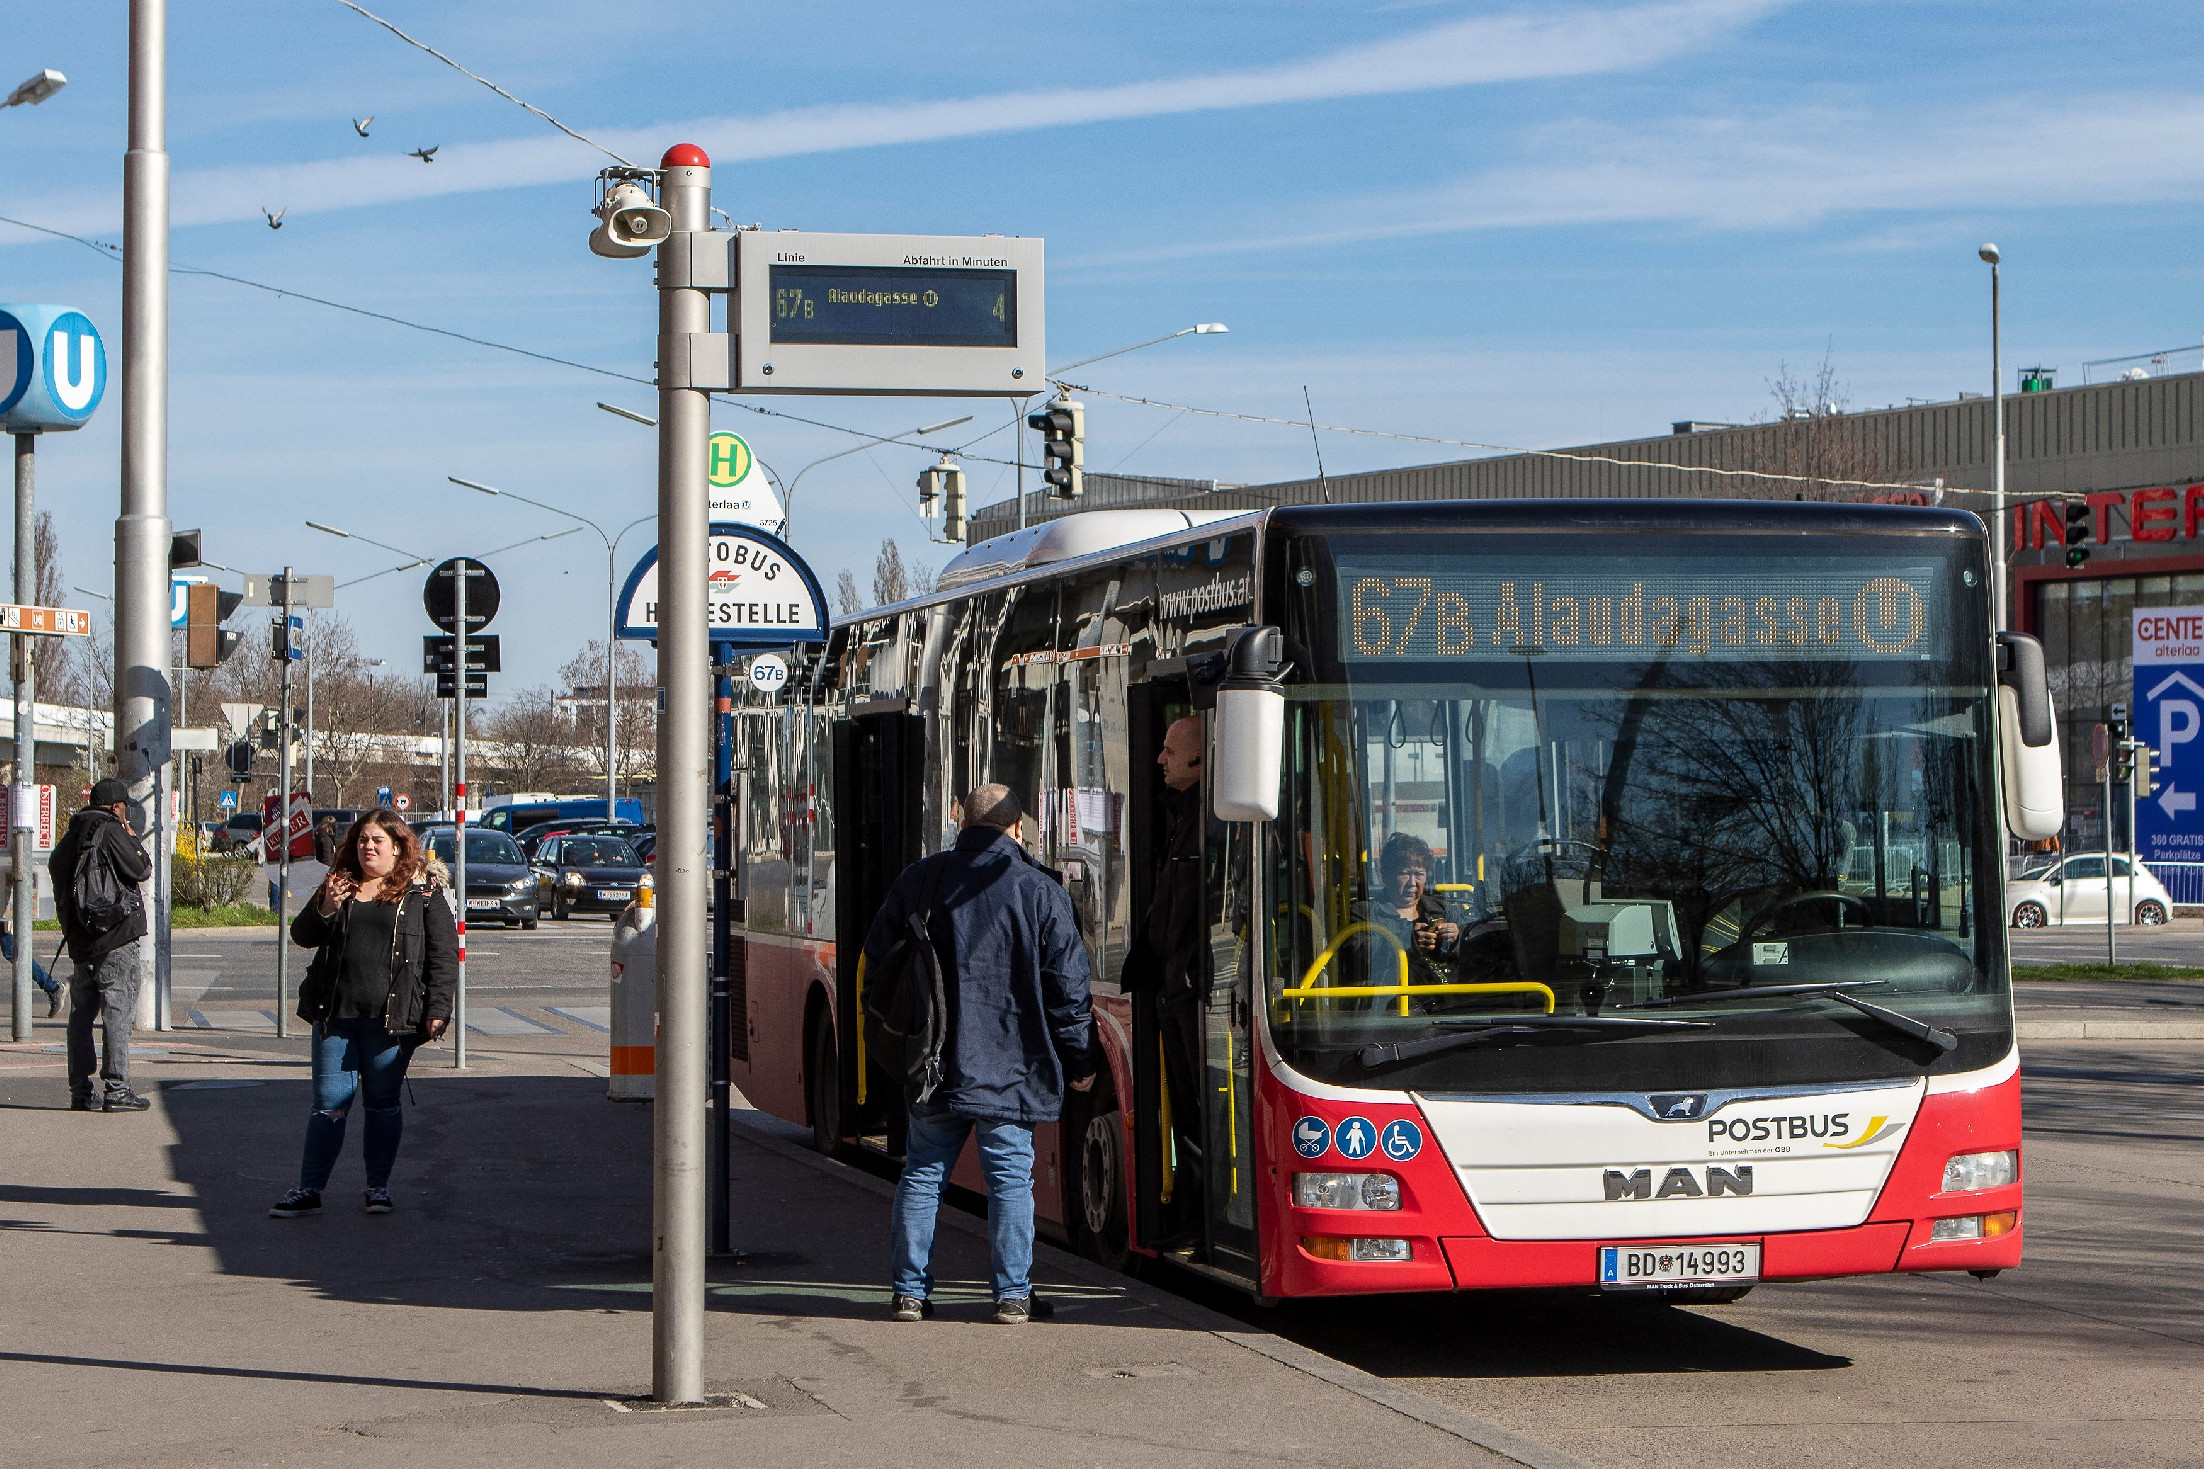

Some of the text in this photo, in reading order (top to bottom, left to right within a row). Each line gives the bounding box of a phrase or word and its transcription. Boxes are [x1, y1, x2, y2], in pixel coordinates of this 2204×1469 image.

[777, 252, 806, 264] Linie
[903, 255, 1008, 268] Abfahrt in Minuten
[776, 288, 815, 321] 67B
[828, 288, 918, 307] Alaudagasse
[991, 293, 1006, 322] 4
[53, 331, 96, 410] U
[711, 442, 738, 477] H
[709, 500, 740, 510] terlaa
[709, 541, 781, 581] OBUS
[645, 602, 800, 624] HESTELLE
[1160, 571, 1251, 624] www.postbus.at
[1352, 577, 1474, 656] 67B
[1492, 581, 1840, 654] Alaudagasse
[754, 665, 784, 680] 67B
[2160, 700, 2200, 767] P
[269, 814, 307, 847] KUER
[2154, 849, 2201, 862] Parkplätze
[1708, 1112, 1850, 1143] POSTBUS
[1603, 1164, 1753, 1200] MAN
[1607, 1250, 1745, 1277] A BD 14993
